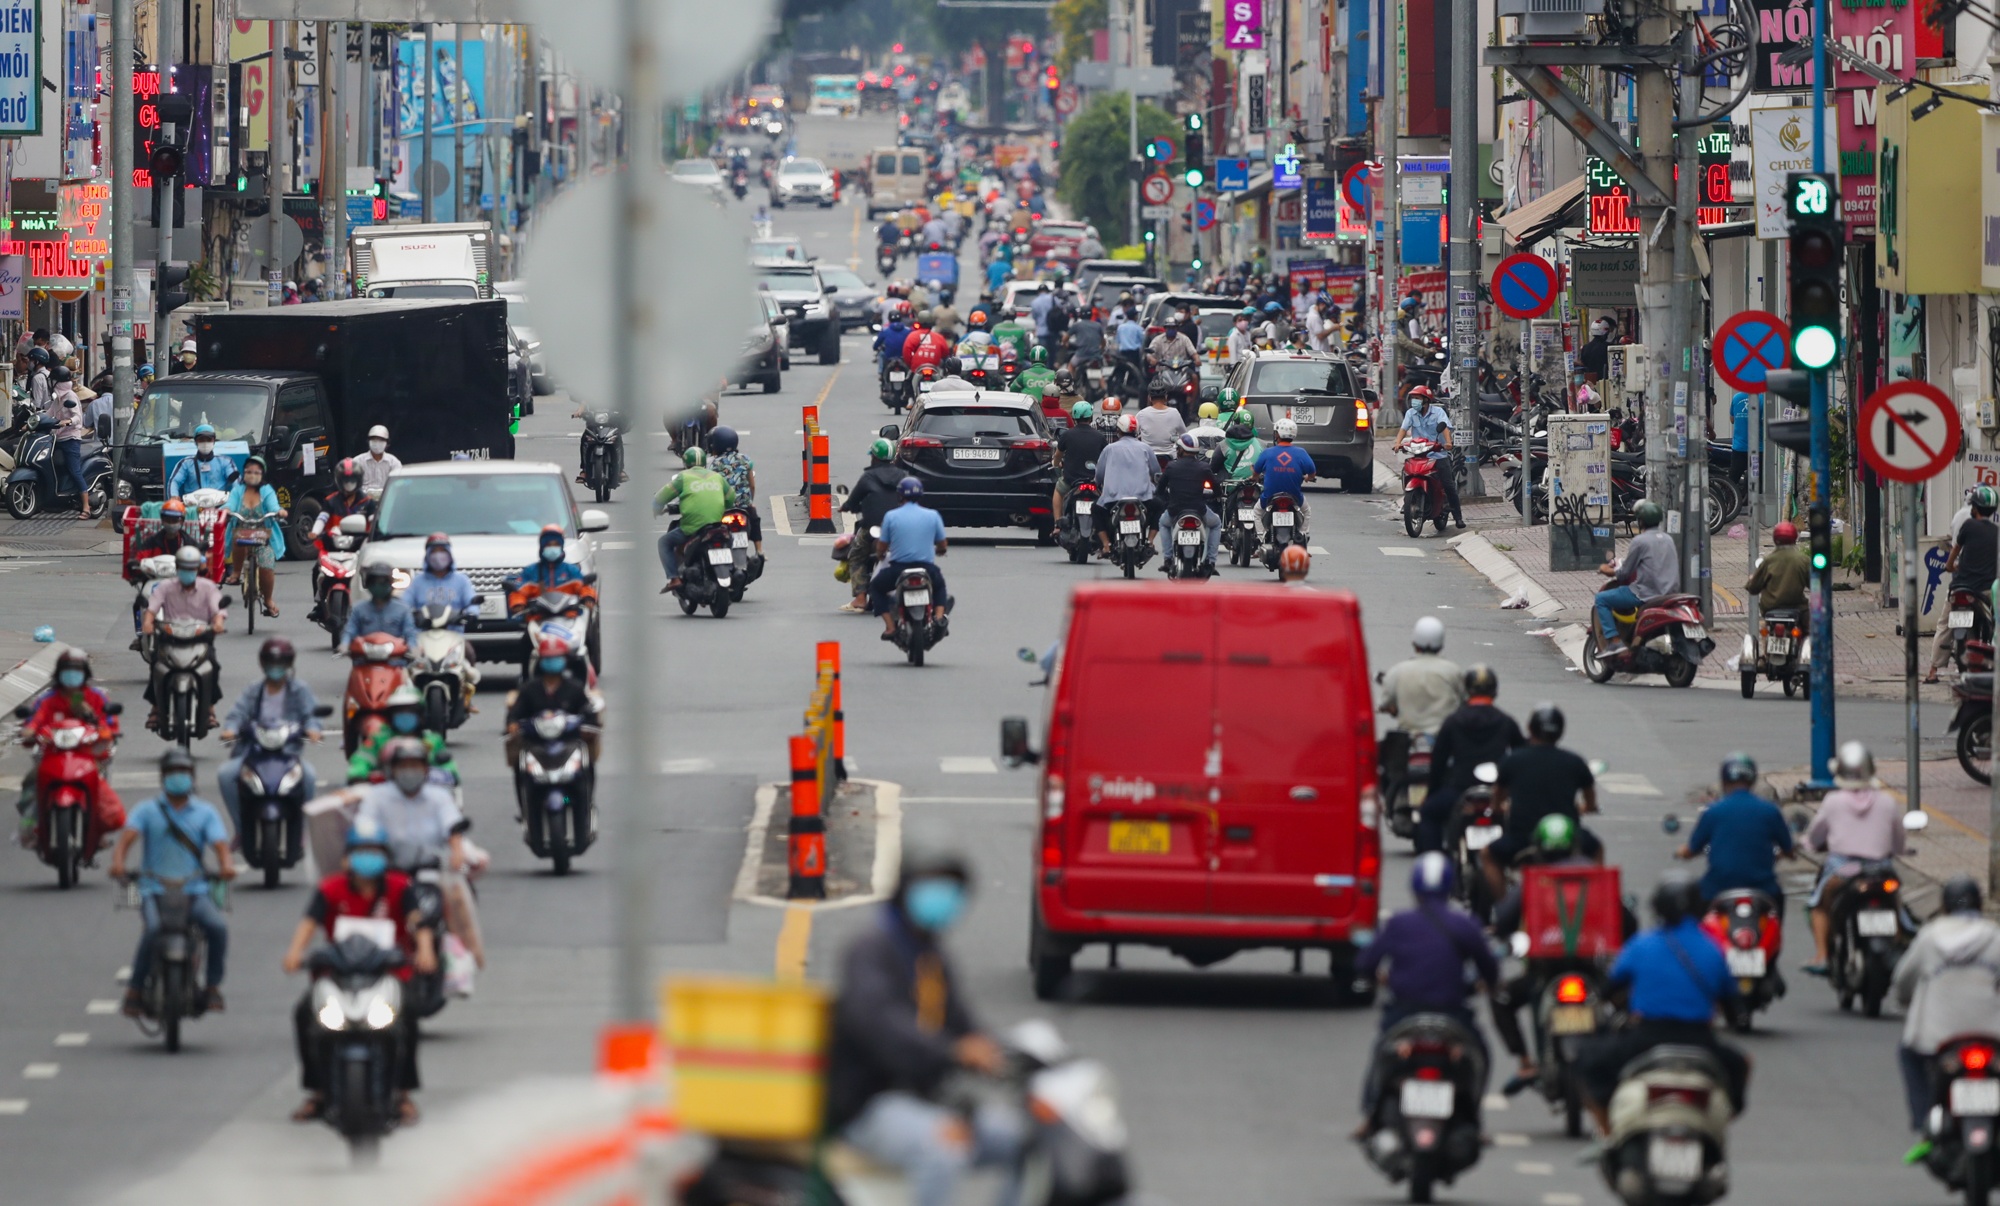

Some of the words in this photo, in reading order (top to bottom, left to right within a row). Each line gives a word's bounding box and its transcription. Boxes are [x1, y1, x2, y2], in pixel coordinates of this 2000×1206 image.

[0, 0, 32, 33] IỂN
[1841, 19, 1903, 71] NỐI
[0, 43, 28, 78] MỖI
[0, 91, 27, 123] GIỜ
[1425, 160, 1450, 172] THUỐ
[1769, 156, 1813, 171] CHUYÊ
[1796, 181, 1827, 213] 20
[1857, 184, 1877, 196] HOT
[1844, 200, 1870, 212] 0947
[21, 217, 46, 230] NHÀ
[86, 221, 97, 236] Y
[74, 239, 108, 254] KHOA
[1579, 259, 1597, 272] hoa
[1293, 415, 1313, 423] 0502
[1974, 465, 2000, 486] Ta
[1102, 776, 1157, 804] ninja
